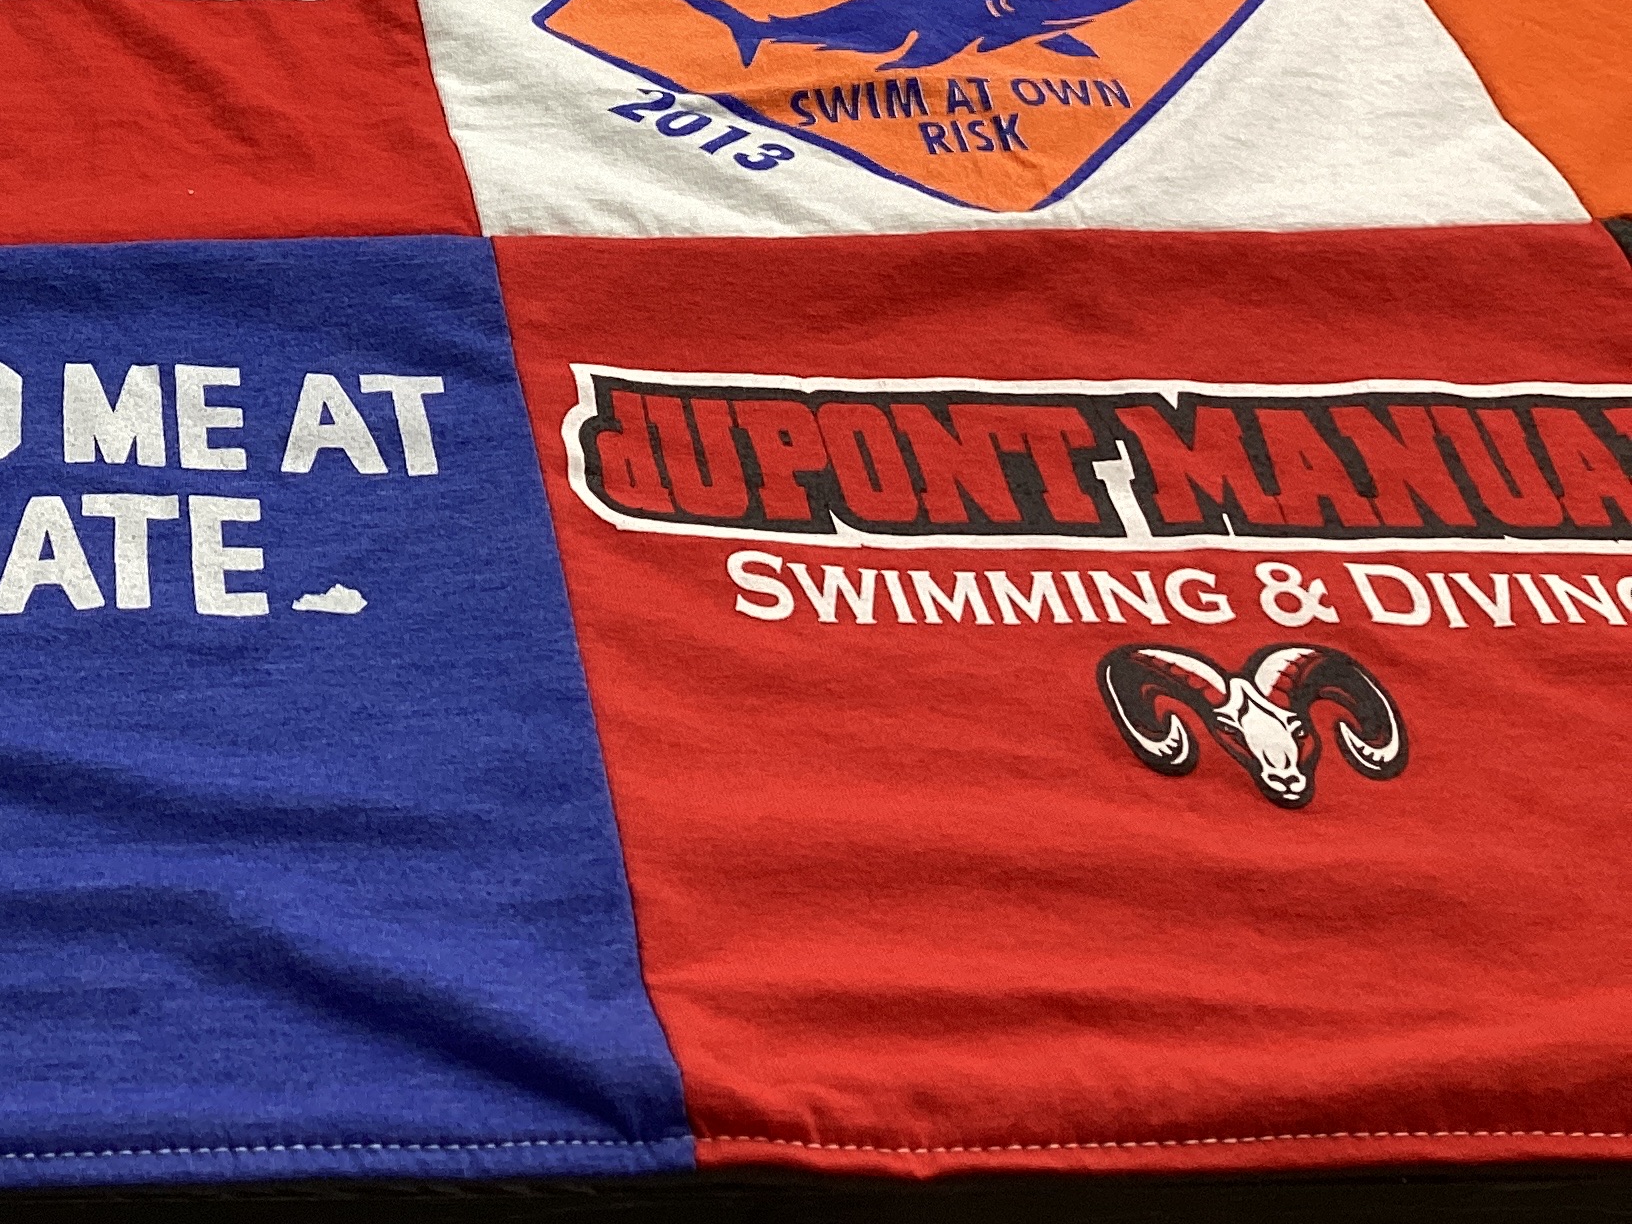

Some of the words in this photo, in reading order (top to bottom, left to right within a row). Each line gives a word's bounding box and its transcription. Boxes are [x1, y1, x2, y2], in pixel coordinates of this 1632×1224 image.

[607, 86, 797, 172] 2013
[789, 78, 929, 128] SWIM
[945, 76, 996, 116] AT
[1010, 76, 1132, 111] OWN
[919, 114, 1030, 157] RISK
[62, 363, 249, 472] ME
[279, 371, 445, 477] AT
[1122, 405, 1632, 532] MANUA
[1260, 561, 1341, 626] &
[1343, 561, 1632, 629] DIVIN
